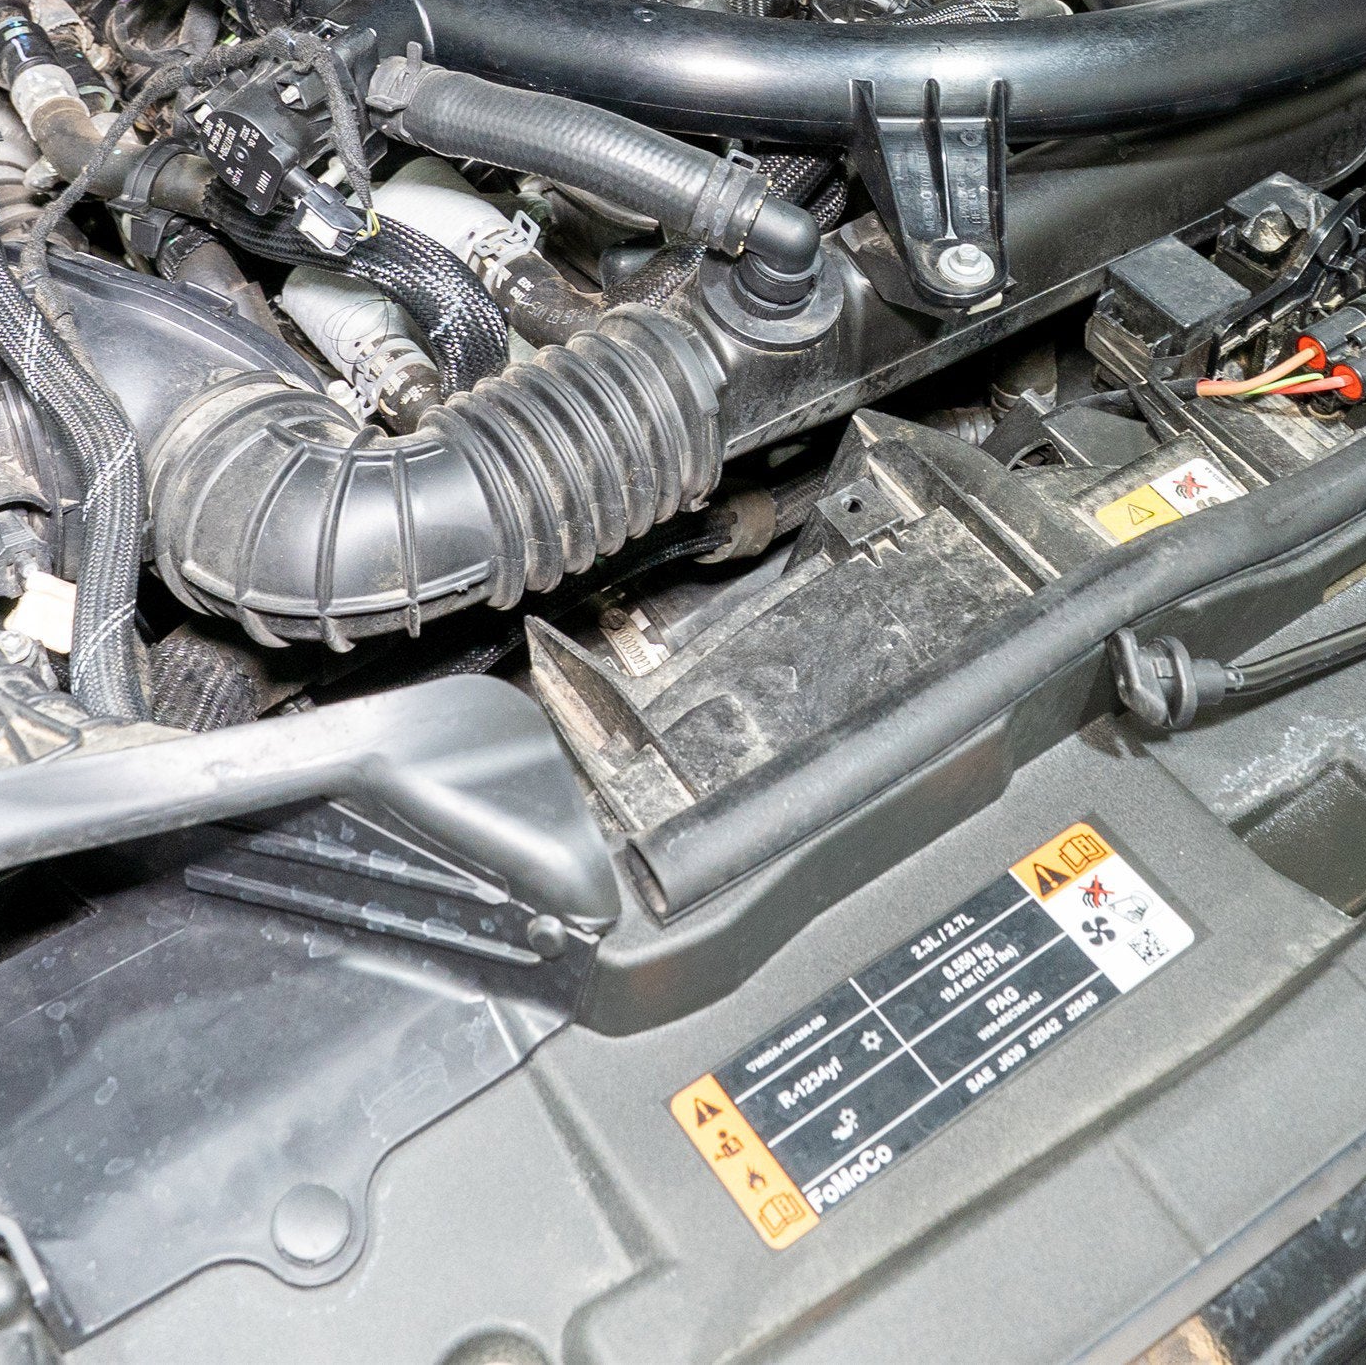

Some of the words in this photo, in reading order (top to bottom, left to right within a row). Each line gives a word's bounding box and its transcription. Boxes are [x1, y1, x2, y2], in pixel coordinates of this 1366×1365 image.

[910, 936, 942, 960] 2.3L
[943, 913, 975, 937] 2.7L
[971, 942, 995, 960] kg
[985, 985, 1020, 1016] PAG
[777, 1055, 843, 1109] R-1234yf
[965, 1065, 997, 1094] SAE
[806, 1144, 893, 1214] FoMoCo
